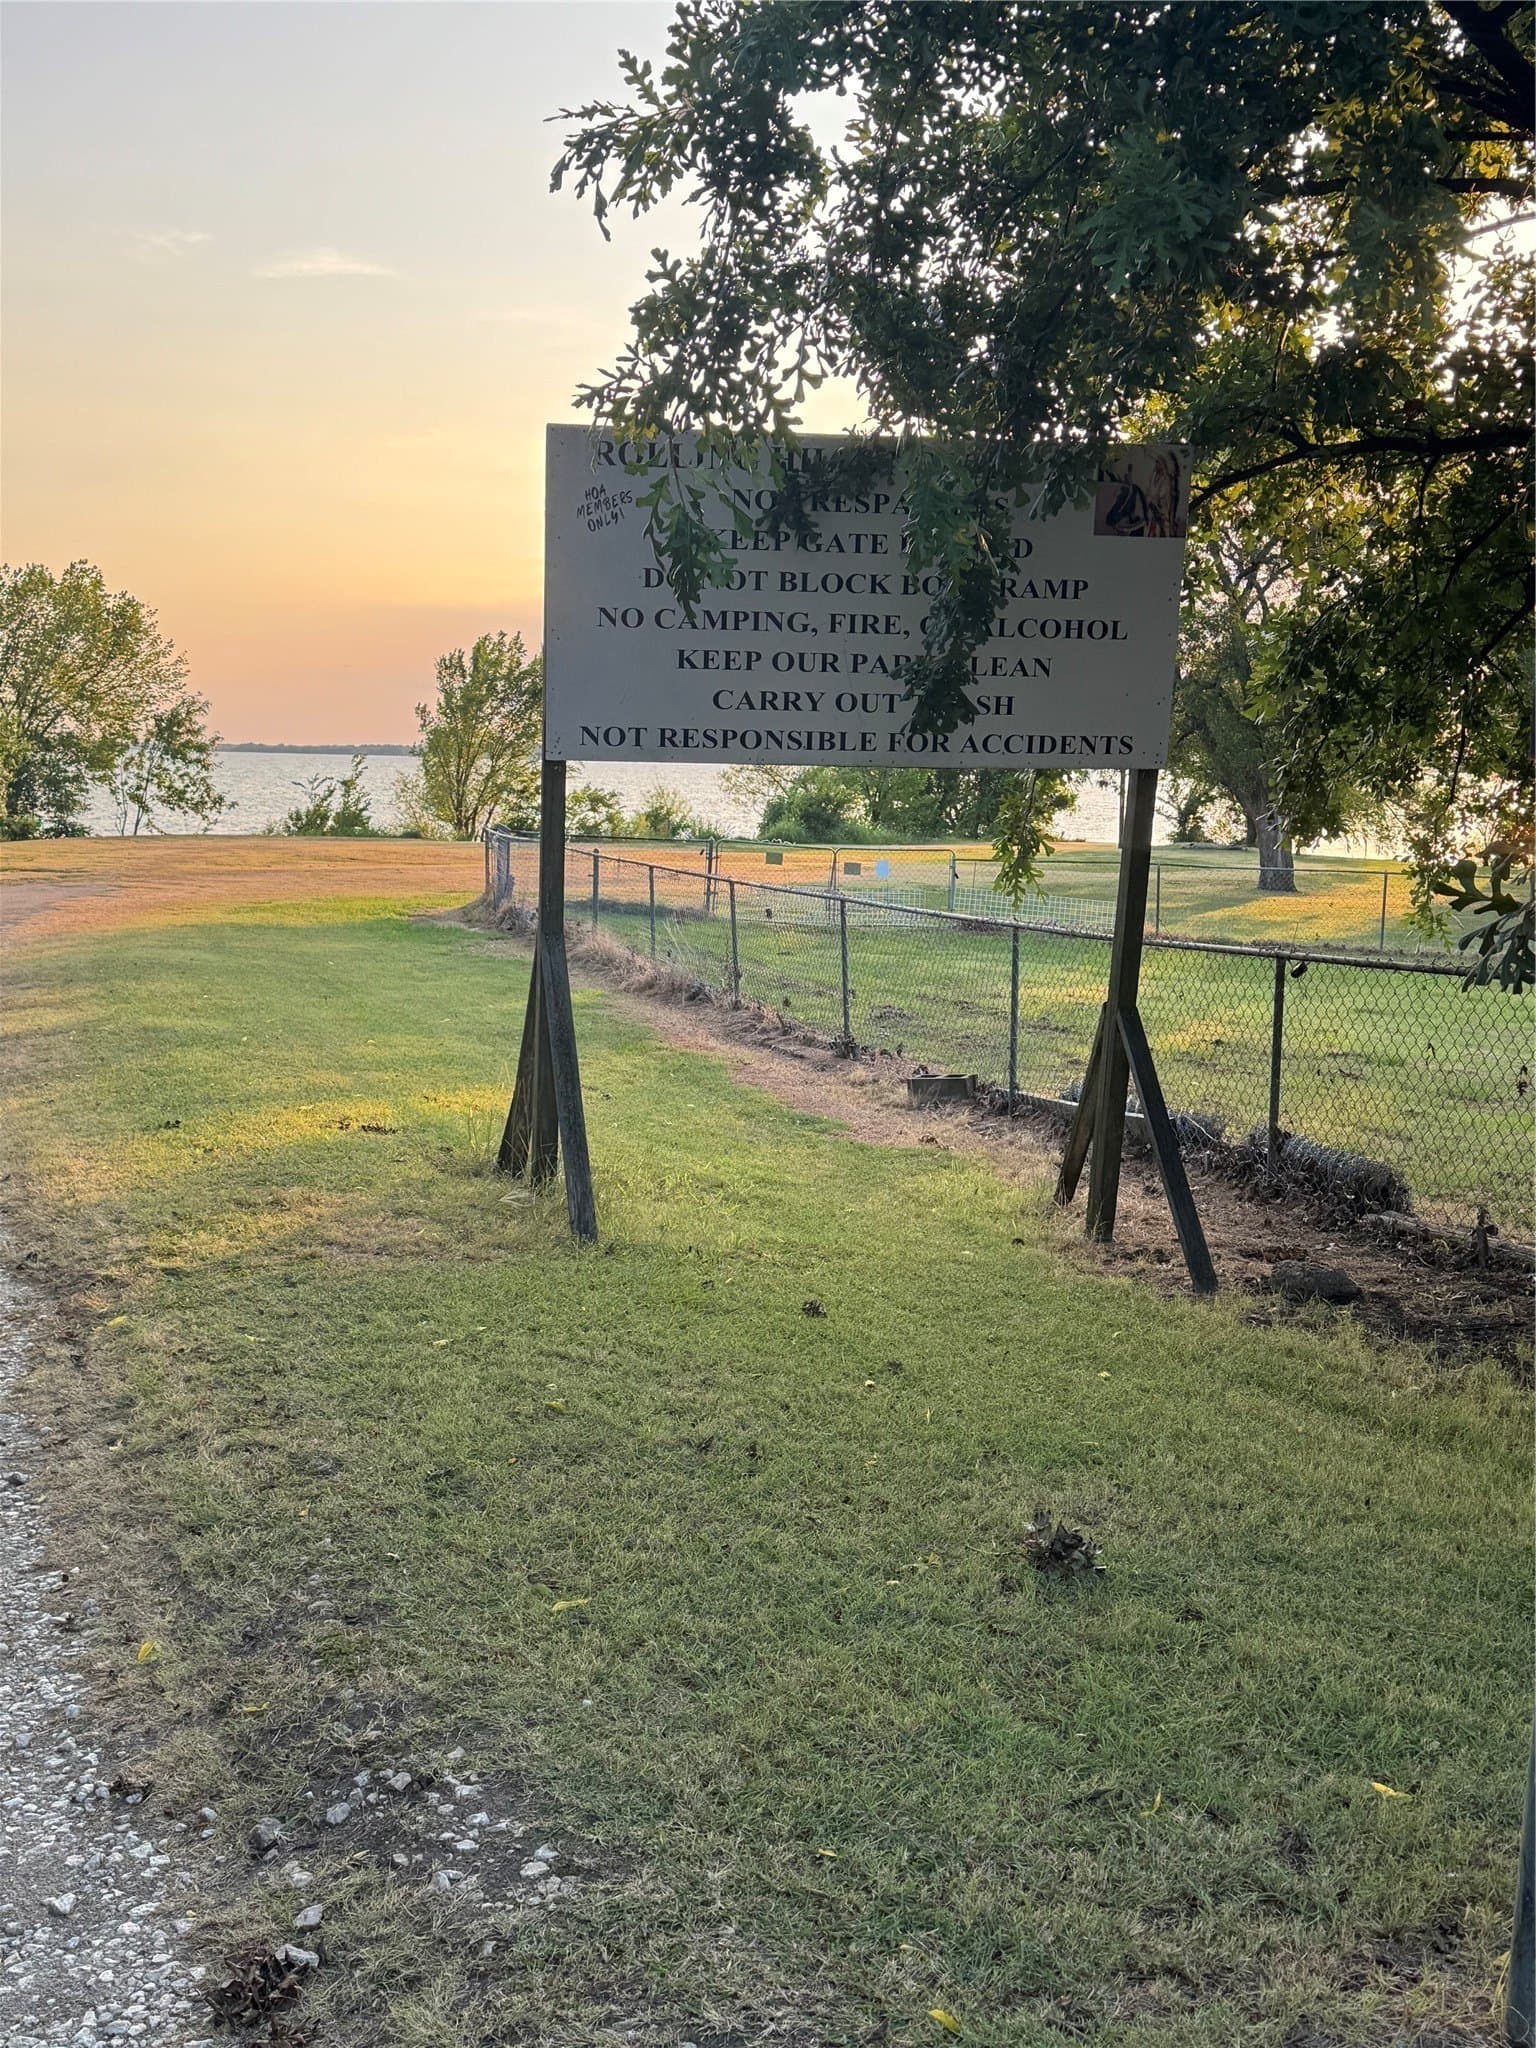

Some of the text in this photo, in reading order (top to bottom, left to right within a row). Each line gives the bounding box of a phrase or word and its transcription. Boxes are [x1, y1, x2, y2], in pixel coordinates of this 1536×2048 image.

[576, 490, 633, 519] MEMBERS
[585, 483, 606, 501] HOA
[732, 488, 776, 511] NO
[801, 532, 889, 554] GATE
[778, 571, 892, 595] BLOCK
[999, 578, 1089, 600] RAMP
[597, 606, 645, 629] NO
[654, 608, 819, 637] CAMPING,
[828, 613, 911, 639] FIRE,
[675, 649, 1052, 678] KEEP OUR PAR LEAN
[712, 689, 826, 712] CARRY
[835, 692, 902, 714] OUT
[579, 726, 1135, 755] NOT RESPONSIBLE FOR ACCIDENTS
